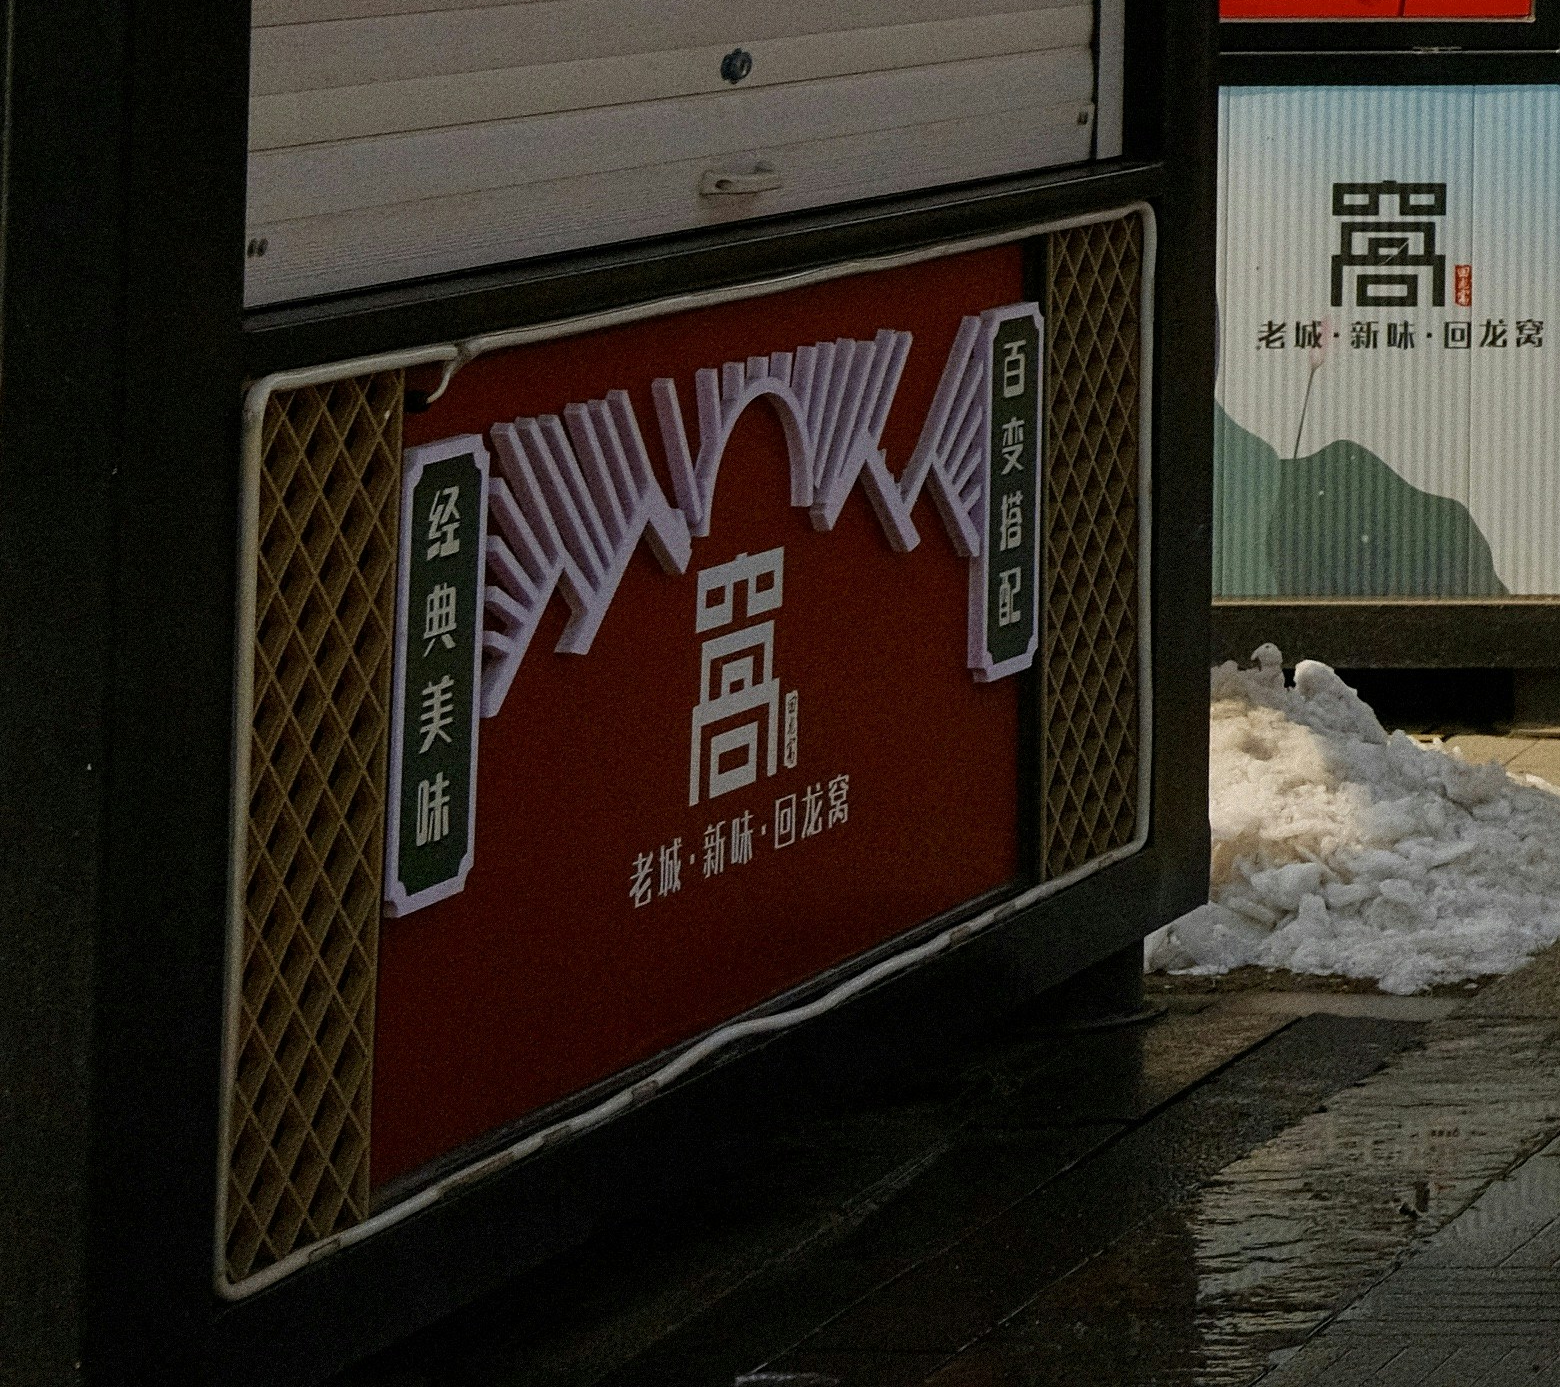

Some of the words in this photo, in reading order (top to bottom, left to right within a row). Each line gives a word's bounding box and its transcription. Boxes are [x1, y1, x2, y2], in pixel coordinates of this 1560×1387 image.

[1257, 319, 1545, 351] 老城·新味·回龙窝
[1000, 338, 1027, 628] 百变搭配
[415, 485, 461, 848] 经典美味
[627, 773, 850, 911] 老城·新味·回龙窝
